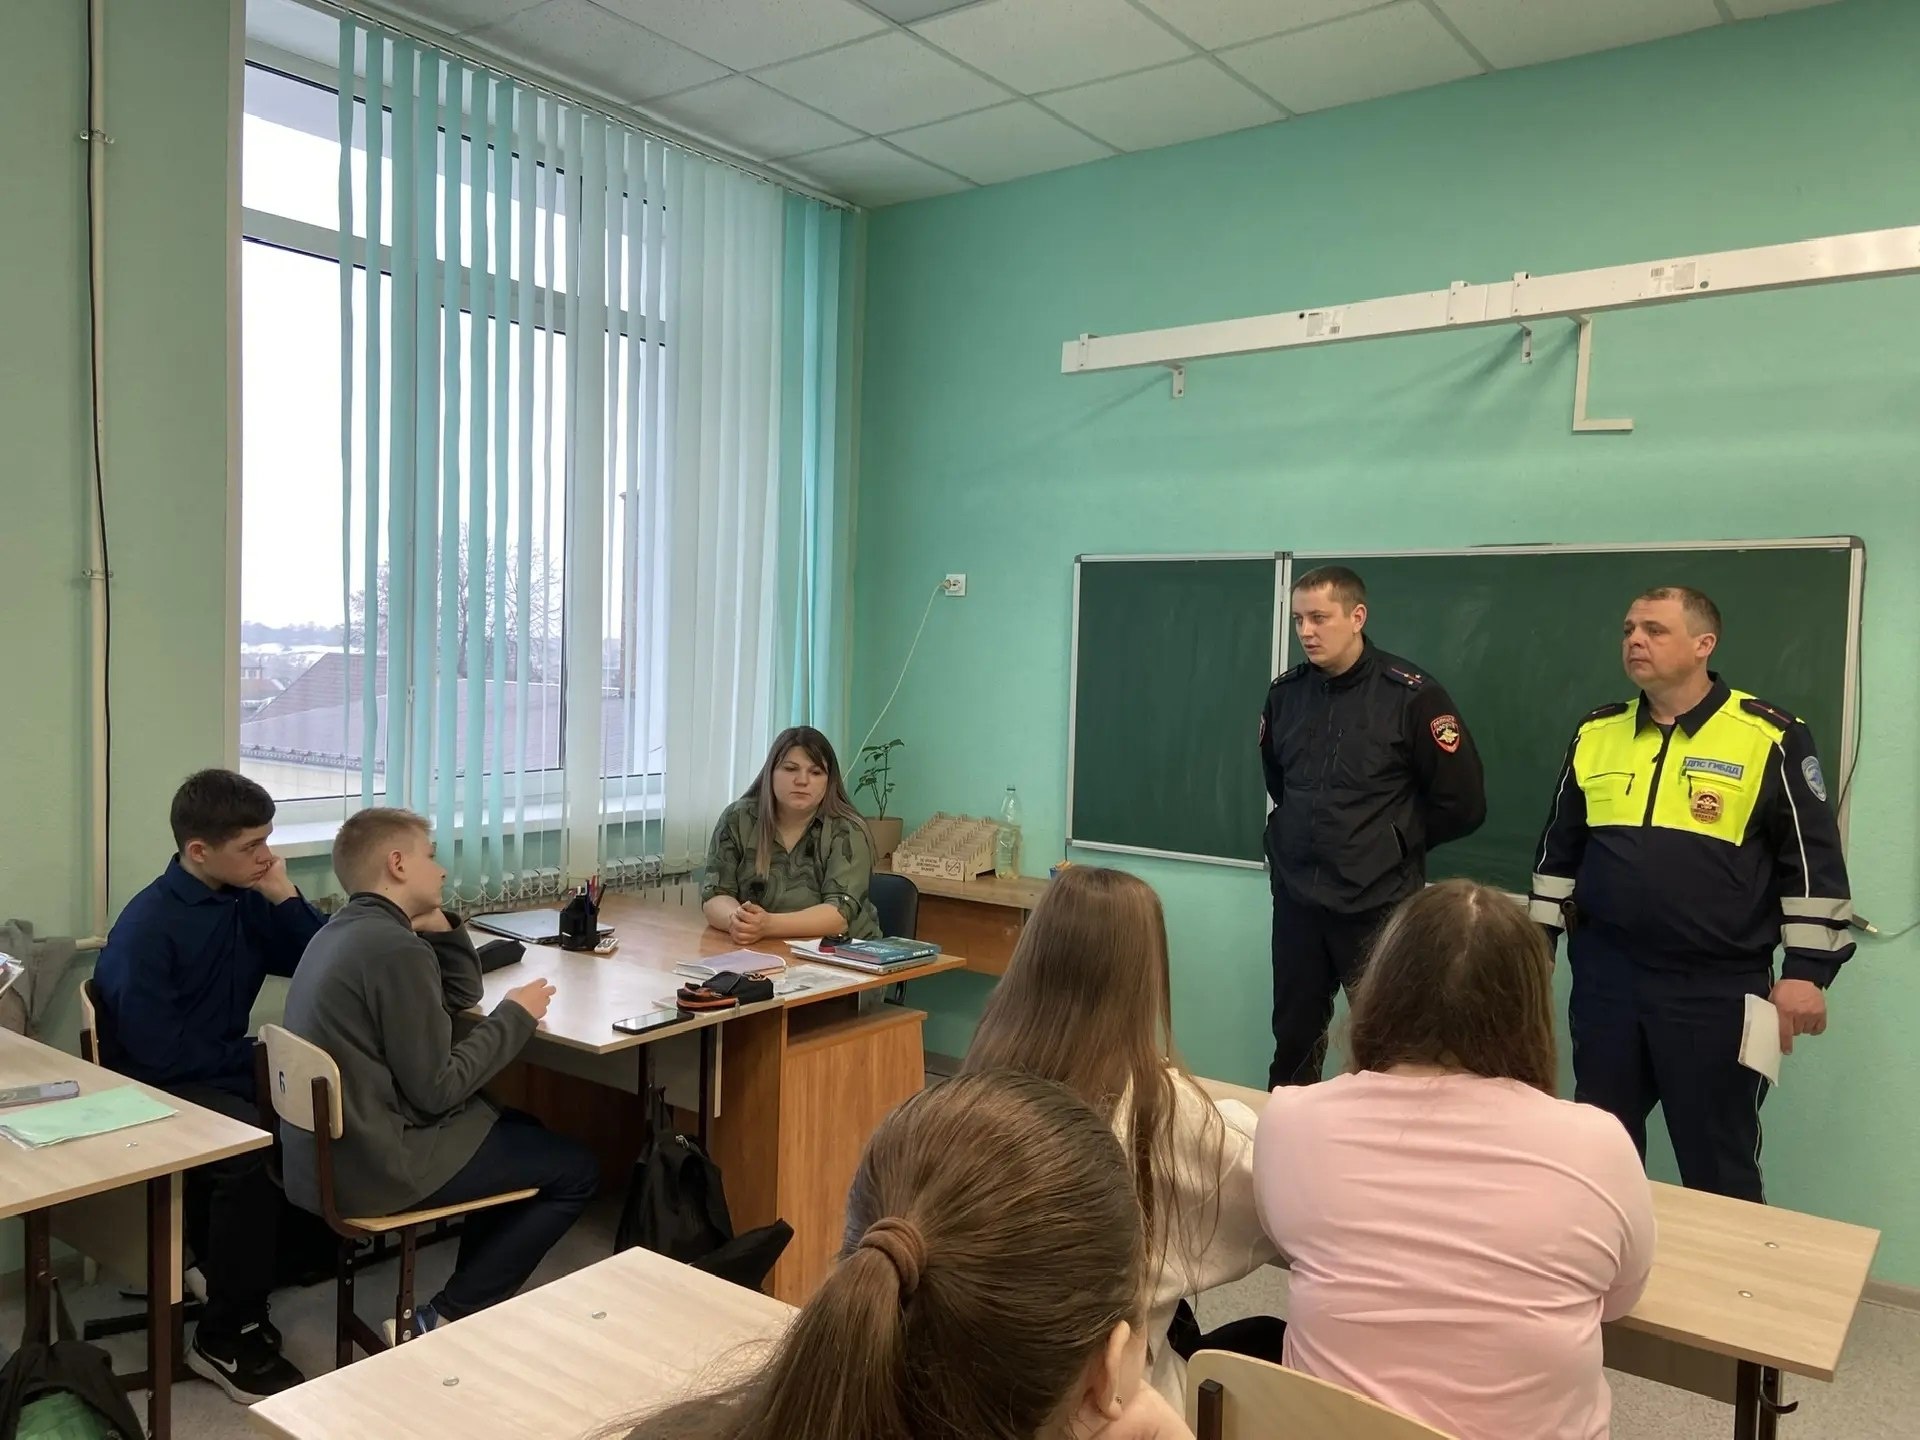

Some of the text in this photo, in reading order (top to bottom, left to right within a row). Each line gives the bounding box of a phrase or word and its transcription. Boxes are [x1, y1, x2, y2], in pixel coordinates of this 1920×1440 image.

[1686, 760, 1740, 776] ДПС ГИБДД
[278, 1071, 286, 1095] 6
